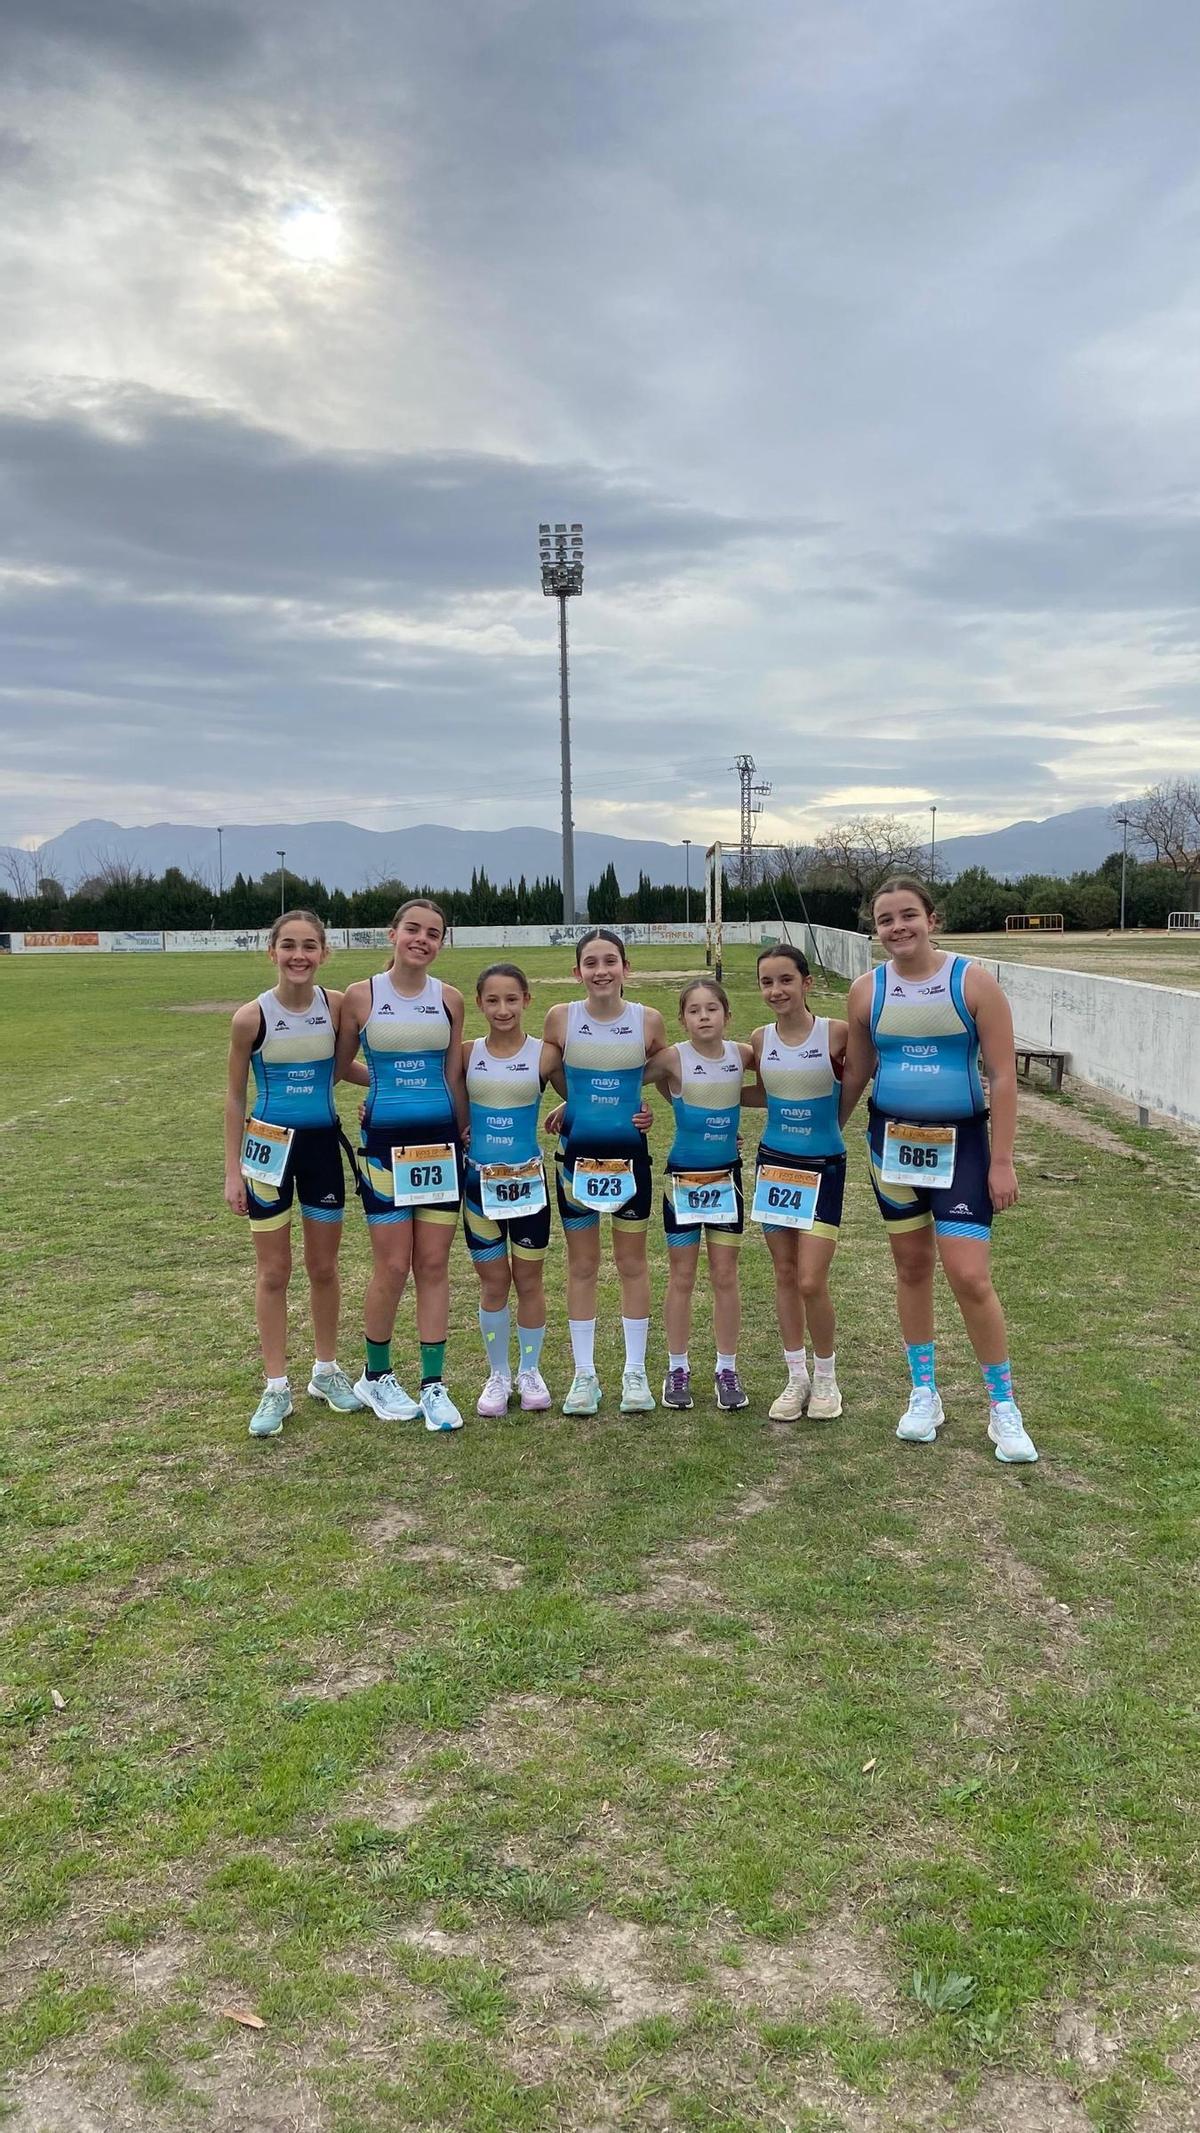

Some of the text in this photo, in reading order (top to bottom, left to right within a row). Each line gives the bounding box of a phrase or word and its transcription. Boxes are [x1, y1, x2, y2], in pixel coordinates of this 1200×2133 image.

[902, 1045, 938, 1055] maya
[394, 1060, 425, 1069] maya
[287, 1069, 315, 1078] maya
[591, 1078, 620, 1087] maya
[781, 1108, 811, 1116] maya
[486, 1116, 513, 1126] maya
[706, 1117, 731, 1125] maya
[245, 1139, 271, 1165] 678
[899, 1145, 938, 1168] 685
[410, 1165, 443, 1187] 673
[496, 1182, 532, 1202] 684
[587, 1178, 622, 1197] 623
[687, 1189, 722, 1209] 622
[768, 1186, 803, 1210] 624
